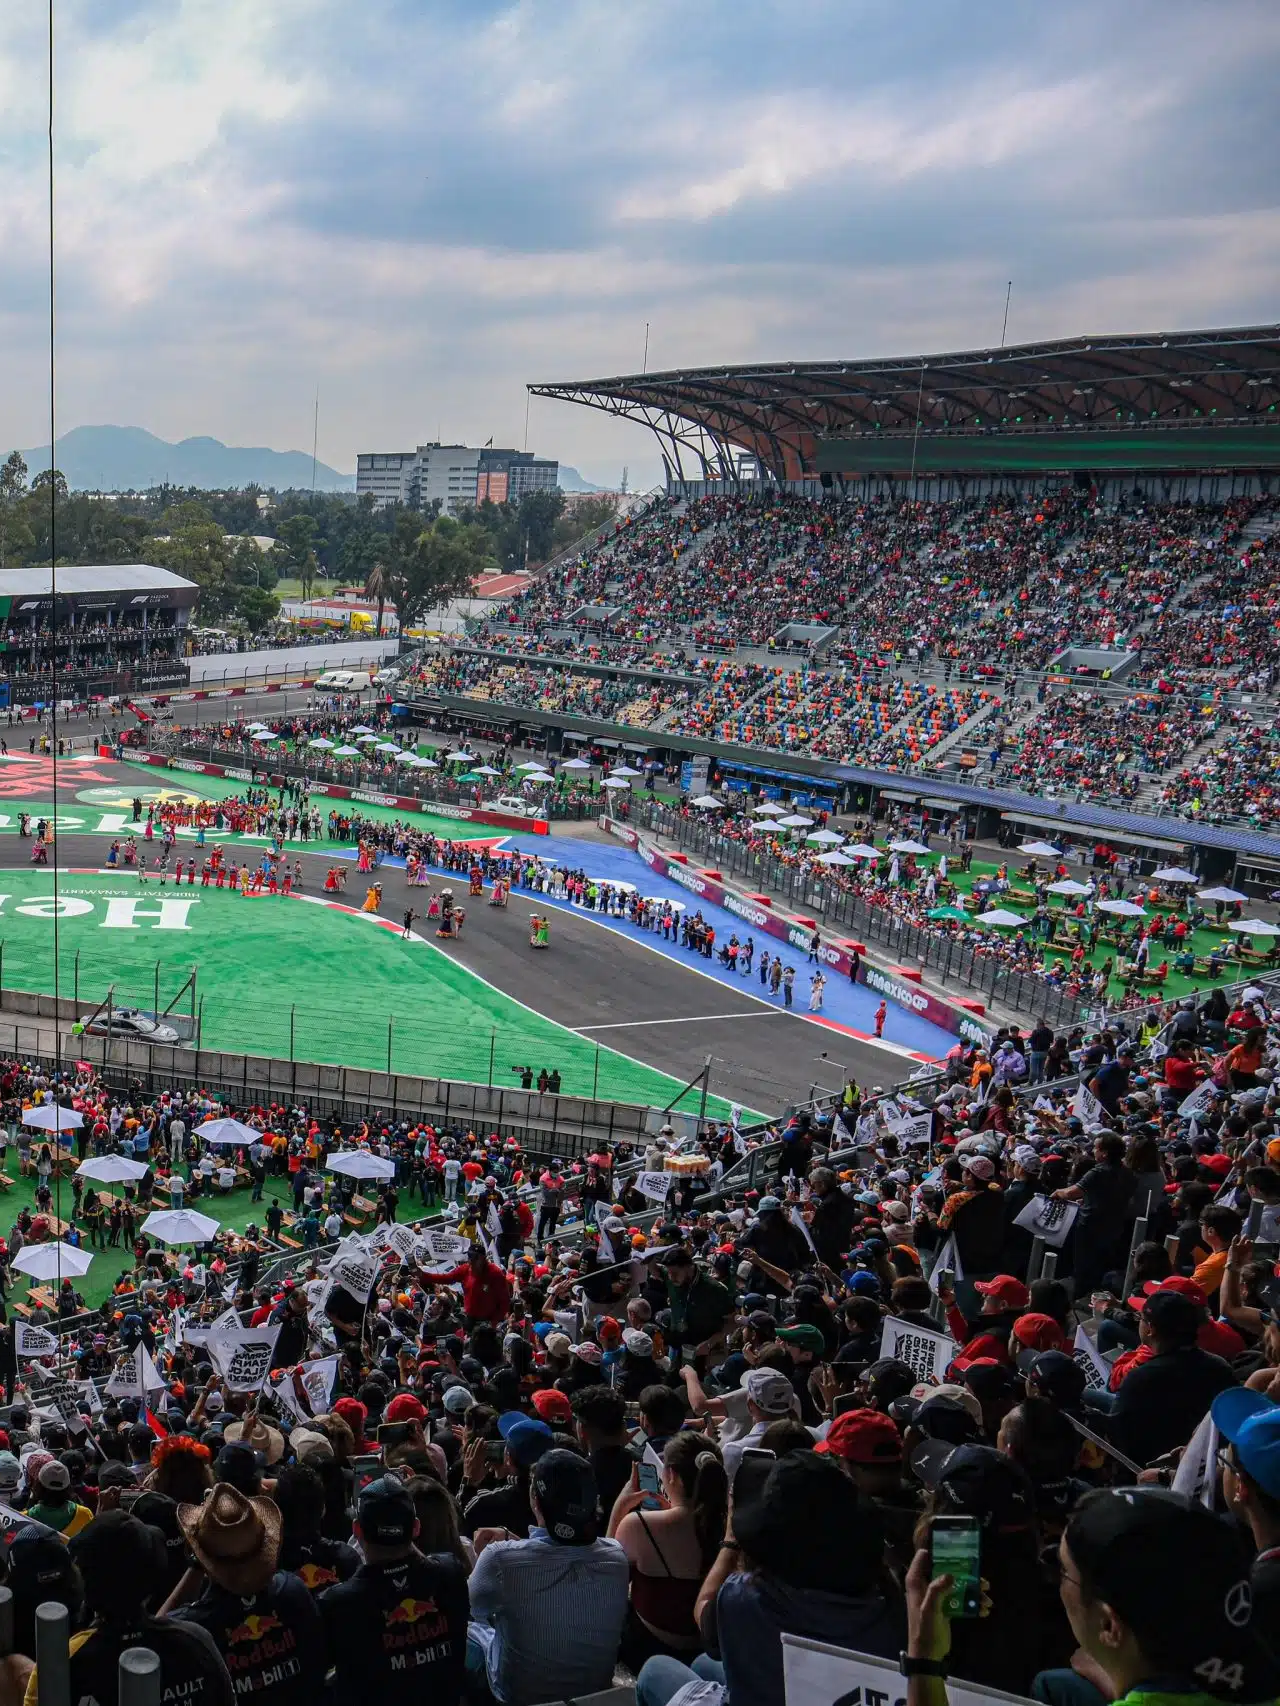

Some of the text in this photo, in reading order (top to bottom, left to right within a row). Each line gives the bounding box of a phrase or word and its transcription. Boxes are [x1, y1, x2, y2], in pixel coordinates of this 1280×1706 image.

[112, 634, 138, 642] MEETS
[142, 631, 182, 640] ELEGANCE
[142, 674, 186, 684] paddockclub.com
[122, 752, 150, 762] MexicoGP
[351, 791, 397, 806] #MexicoGP
[422, 803, 472, 818] #MexicoGP
[668, 865, 706, 893] #MexicoGP
[724, 894, 767, 925] #MexicoGP
[788, 929, 840, 964] #MecoGP
[866, 970, 928, 1011] #MexicoGP
[226, 1628, 296, 1670] Red Bull
[390, 1646, 436, 1671] Mobil
[235, 1664, 283, 1695] Mobil
[1193, 1657, 1245, 1690] 44
[163, 1677, 205, 1701] AULT
